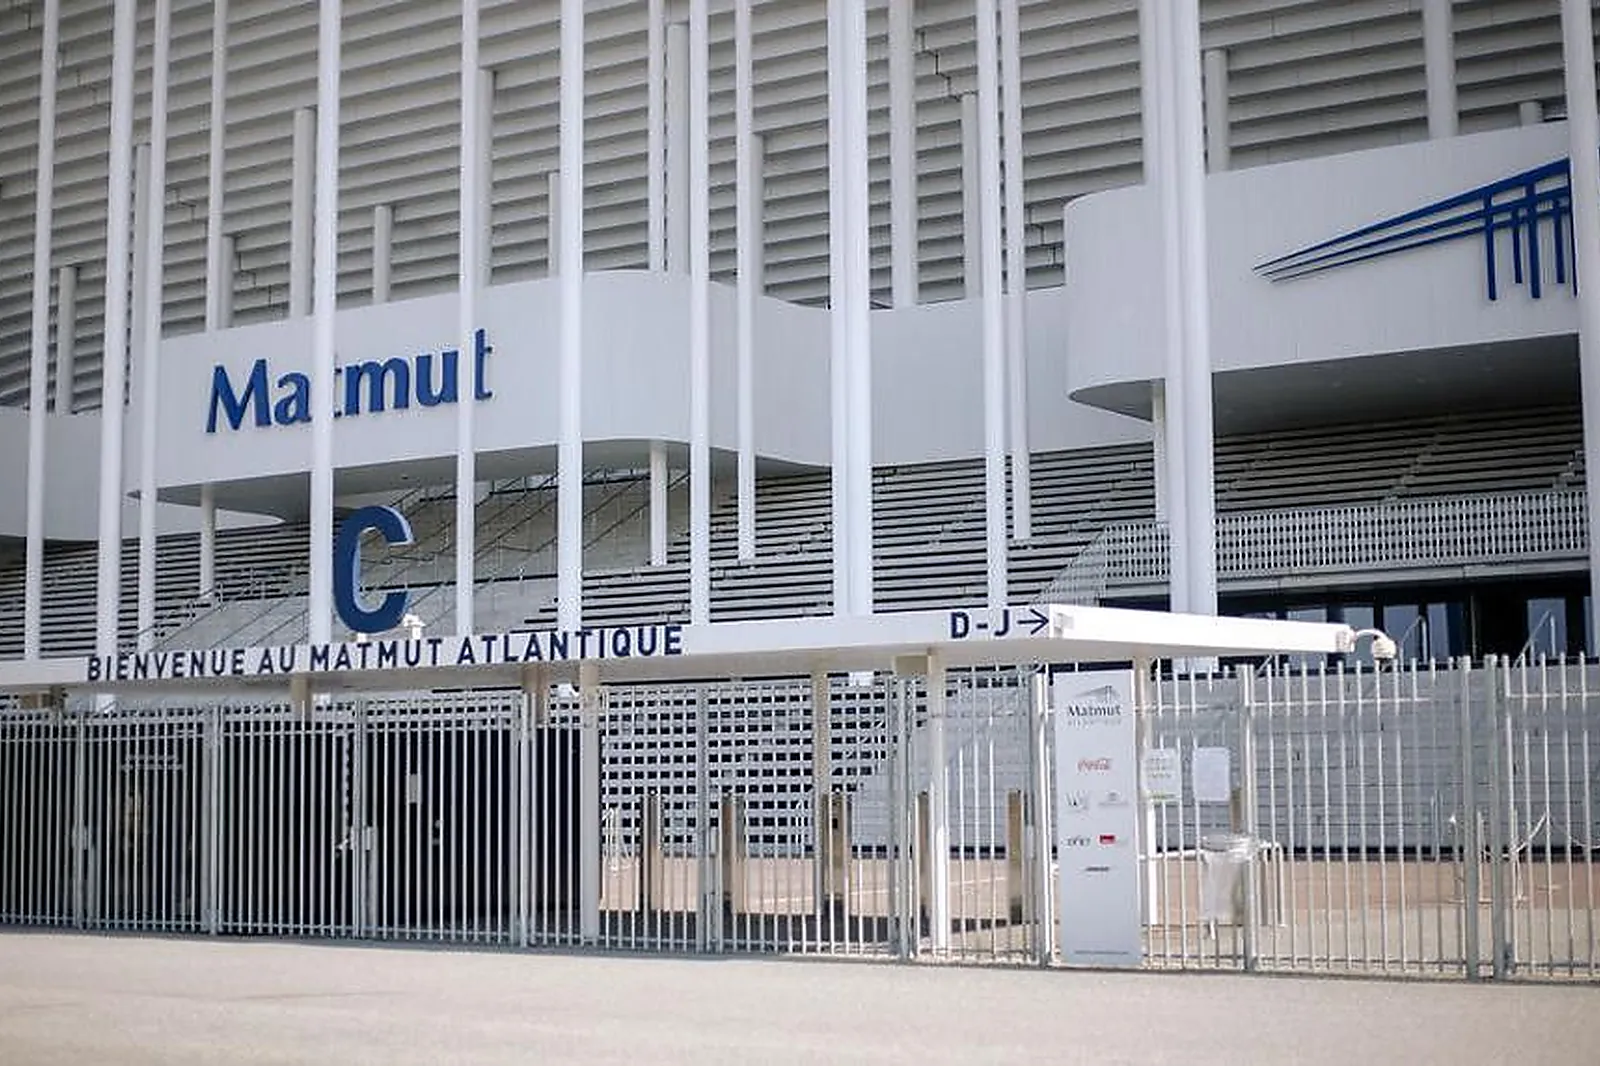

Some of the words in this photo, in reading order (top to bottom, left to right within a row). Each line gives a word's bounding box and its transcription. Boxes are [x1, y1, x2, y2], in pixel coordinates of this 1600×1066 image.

[206, 328, 493, 433] Mamut
[333, 505, 414, 635] C
[87, 648, 246, 681] BIENVENUE
[258, 645, 297, 673] AU
[310, 638, 443, 672] MATMUT
[457, 625, 683, 665] ATLANTIQUE
